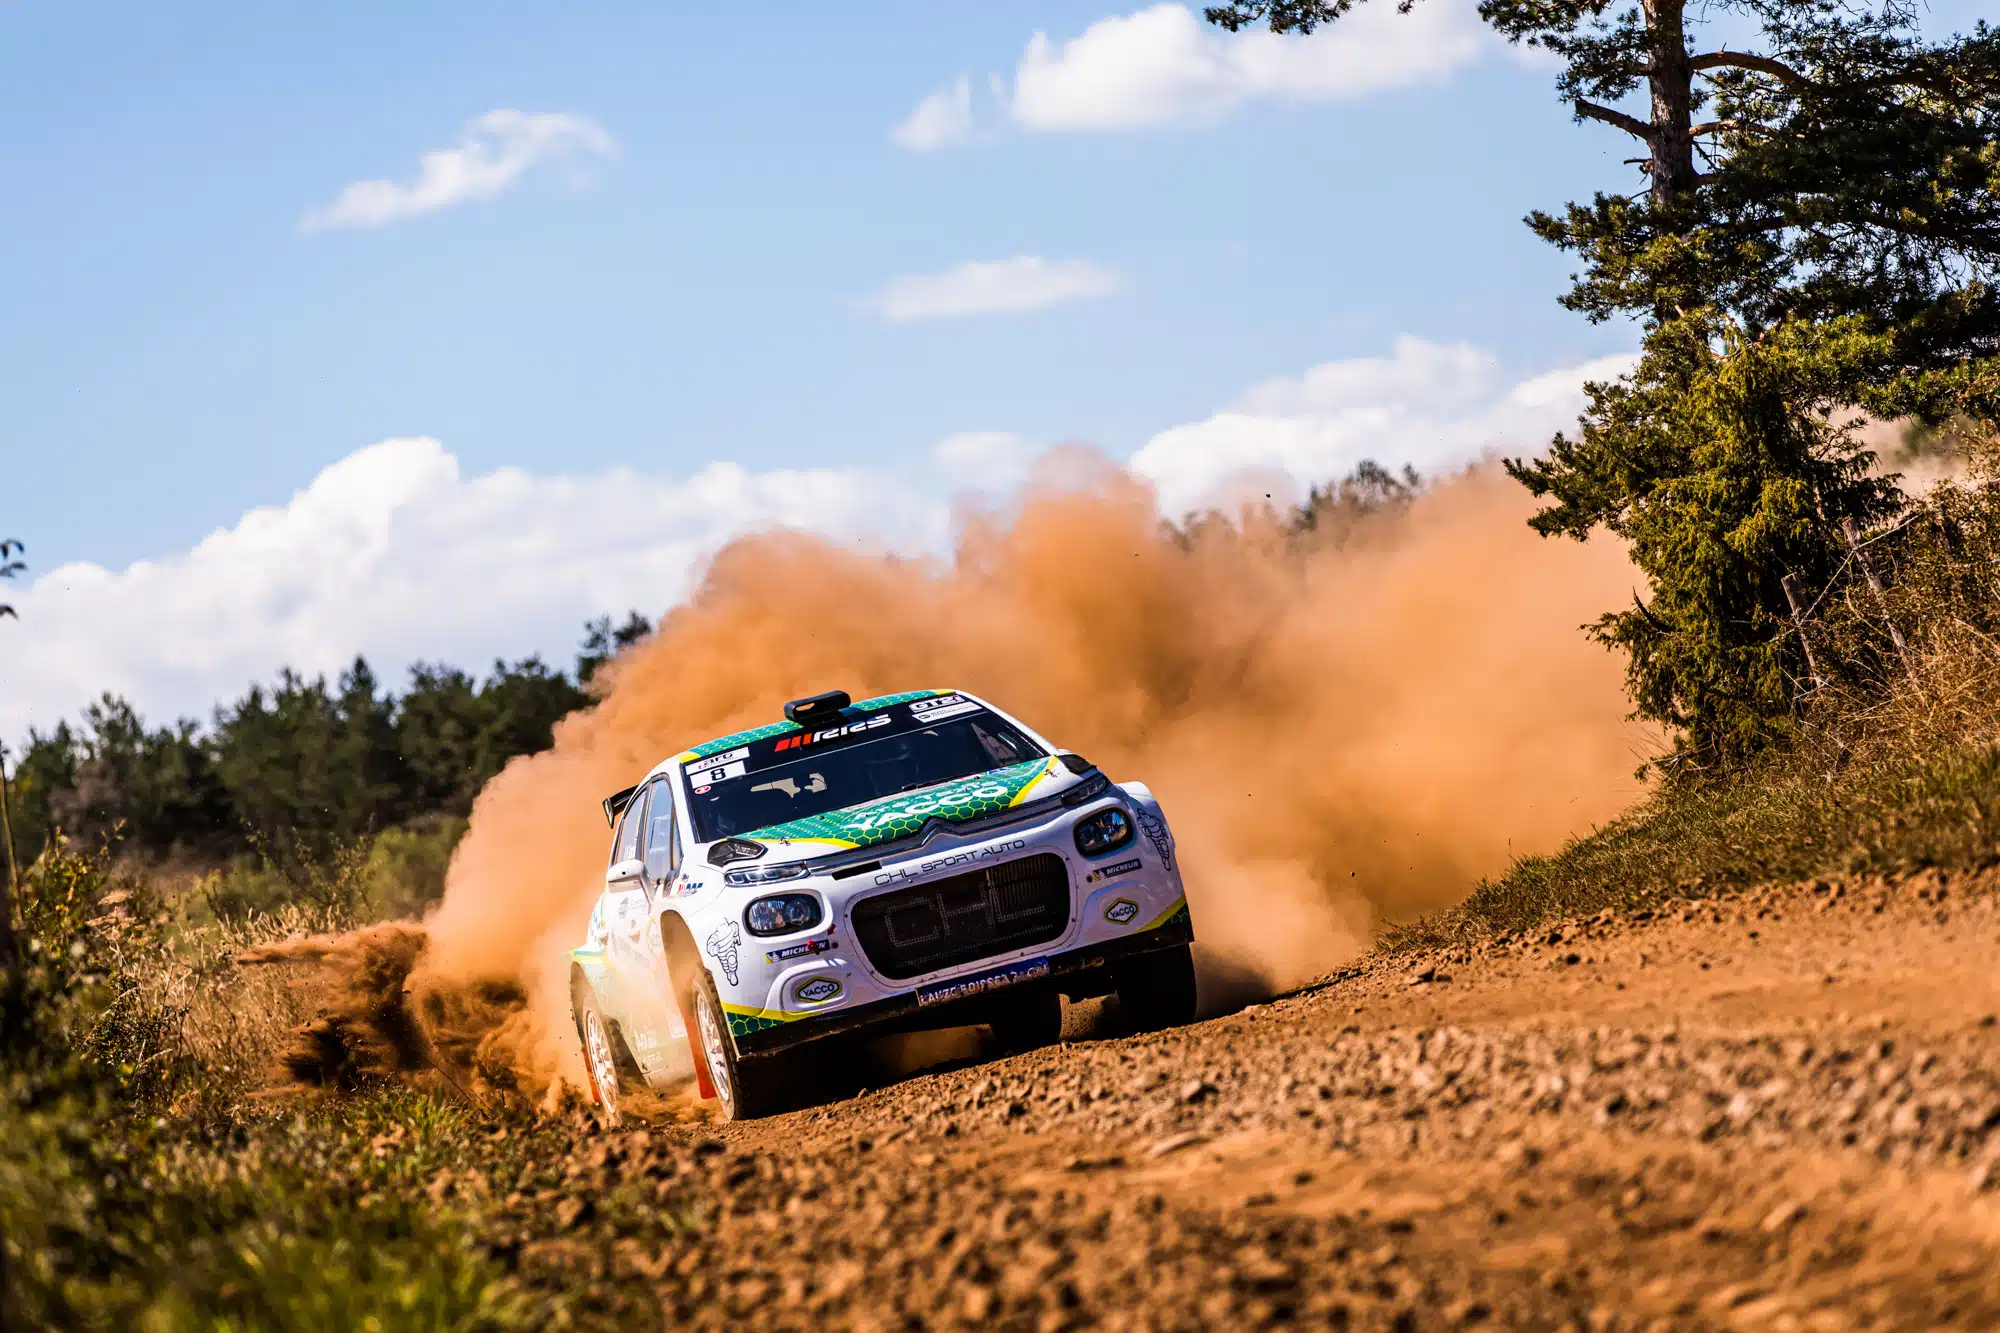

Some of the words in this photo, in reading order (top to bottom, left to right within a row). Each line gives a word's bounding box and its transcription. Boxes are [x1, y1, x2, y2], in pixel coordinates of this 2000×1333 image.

[710, 767, 727, 781] 8
[843, 785, 1008, 831] YACCO
[874, 868, 918, 886] CHL
[921, 850, 978, 873] SPORT
[981, 839, 1025, 858] AUTO
[1106, 861, 1139, 875] MICHELIN
[1109, 904, 1135, 918] YACCO
[803, 982, 835, 997] YACCO
